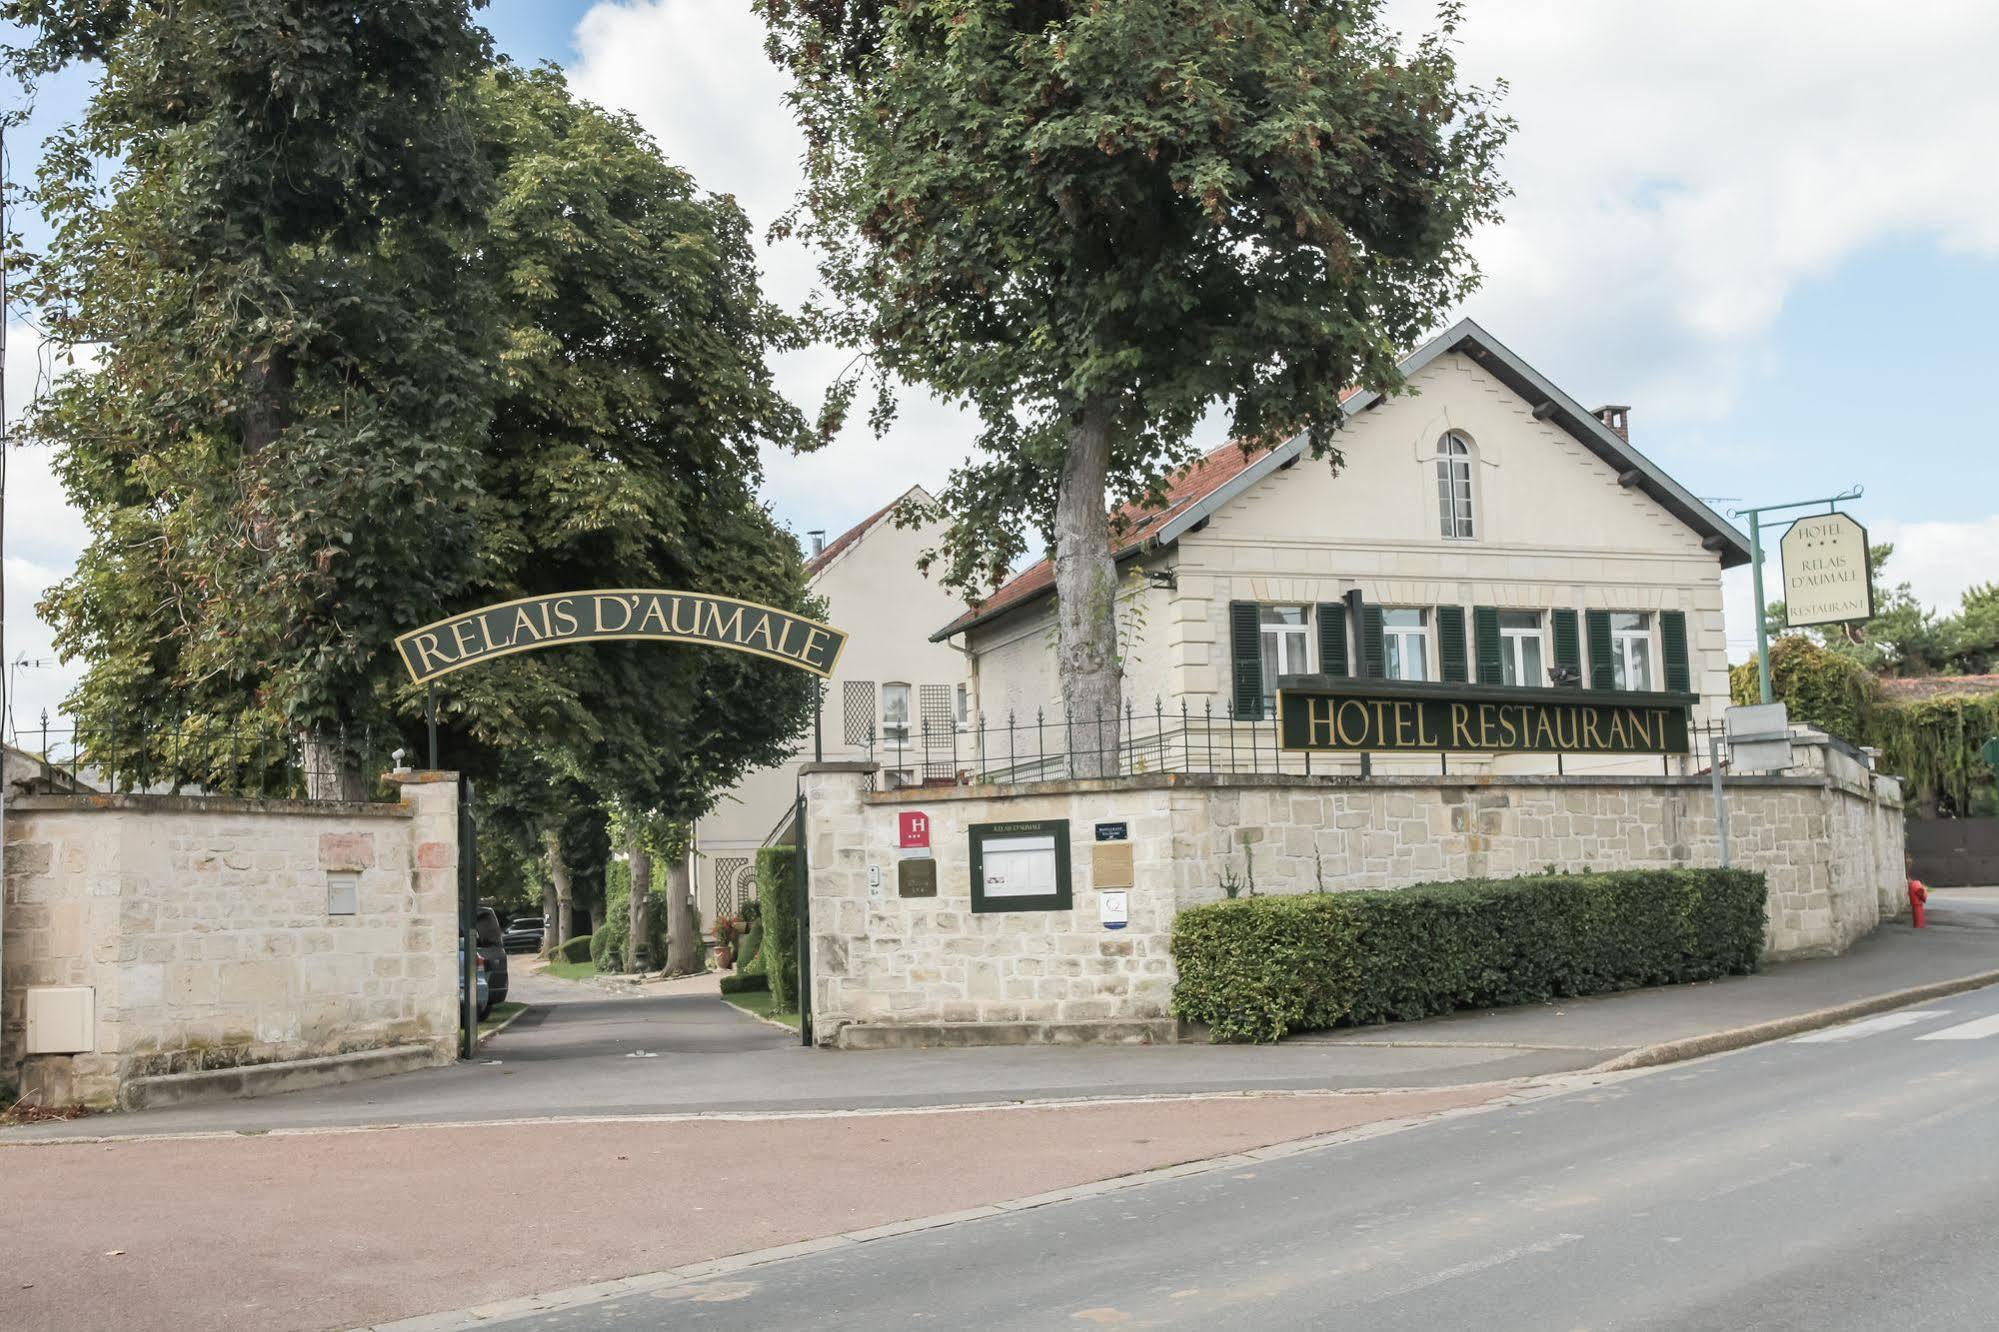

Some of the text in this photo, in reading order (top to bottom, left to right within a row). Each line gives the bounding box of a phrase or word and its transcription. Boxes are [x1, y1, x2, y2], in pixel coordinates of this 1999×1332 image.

[1798, 523, 1843, 540] HOTEL
[1802, 556, 1847, 572] RELAIS
[1791, 570, 1857, 588] D'AUMALE
[1790, 599, 1864, 617] RESTAURANT
[412, 594, 830, 673] RELAIS D'AUMALE
[1306, 698, 1670, 750] HOTEL RESTAURANT
[912, 818, 925, 832] H
